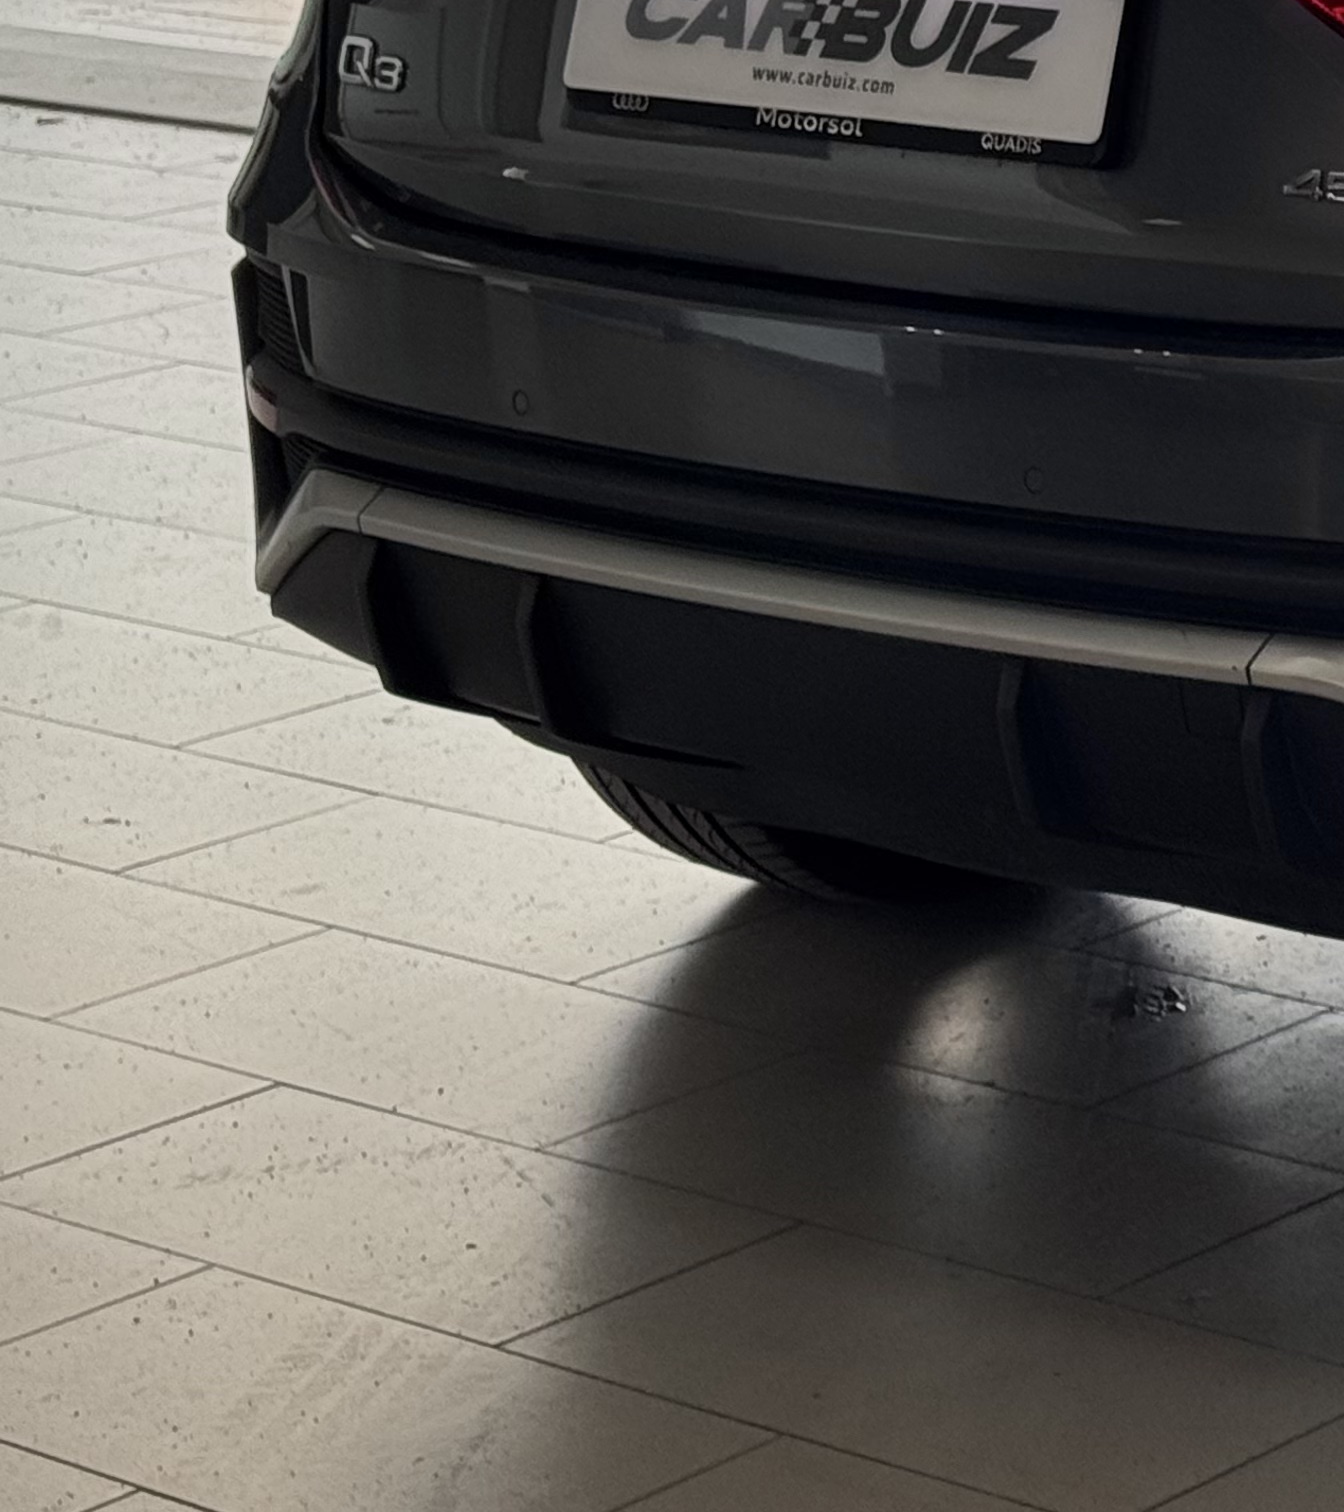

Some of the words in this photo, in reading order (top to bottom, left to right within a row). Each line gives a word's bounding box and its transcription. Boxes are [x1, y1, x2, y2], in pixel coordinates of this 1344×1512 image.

[339, 36, 404, 92] Q3
[752, 66, 896, 95] www.carbuiz.com
[756, 106, 863, 137] Motorsol
[981, 133, 1042, 155] QUADIS
